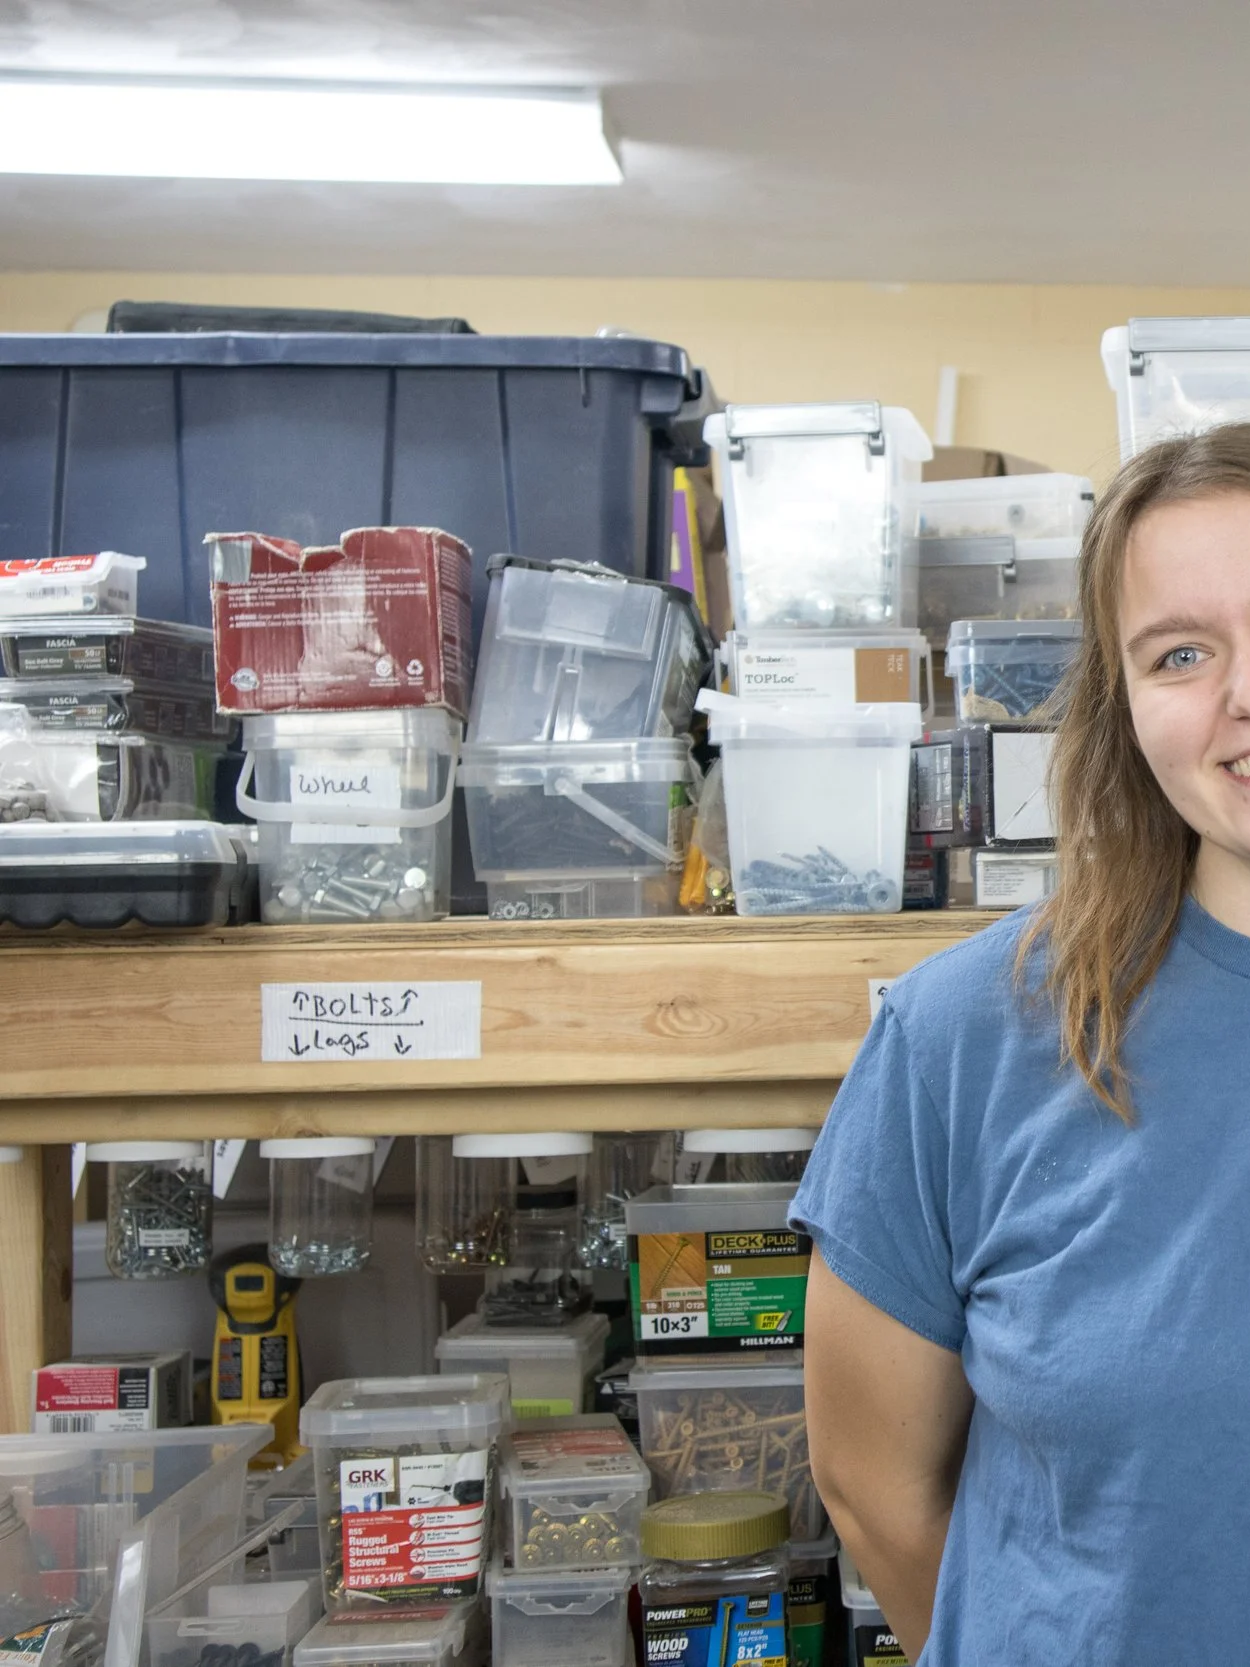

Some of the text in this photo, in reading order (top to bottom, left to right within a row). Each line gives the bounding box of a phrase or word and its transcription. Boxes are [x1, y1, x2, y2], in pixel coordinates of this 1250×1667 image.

[46, 639, 77, 649] FASCIA
[744, 673, 795, 684] TOPLoc
[49, 696, 79, 705] FASCIA
[714, 1233, 796, 1248] DECK PLUS
[750, 1247, 797, 1255] GUARANTEE
[712, 1264, 732, 1275] TAN
[763, 1314, 779, 1322] FREE
[761, 1321, 775, 1329] BIT!
[740, 1335, 794, 1346] HILLMAN
[348, 1468, 386, 1484] GRK
[349, 1535, 387, 1548] Rugged
[349, 1545, 399, 1557] Structural
[349, 1557, 387, 1568] Screws
[646, 1607, 709, 1621] POWERPRO
[648, 1637, 689, 1653] WOOD
[648, 1651, 682, 1661] SCREWS
